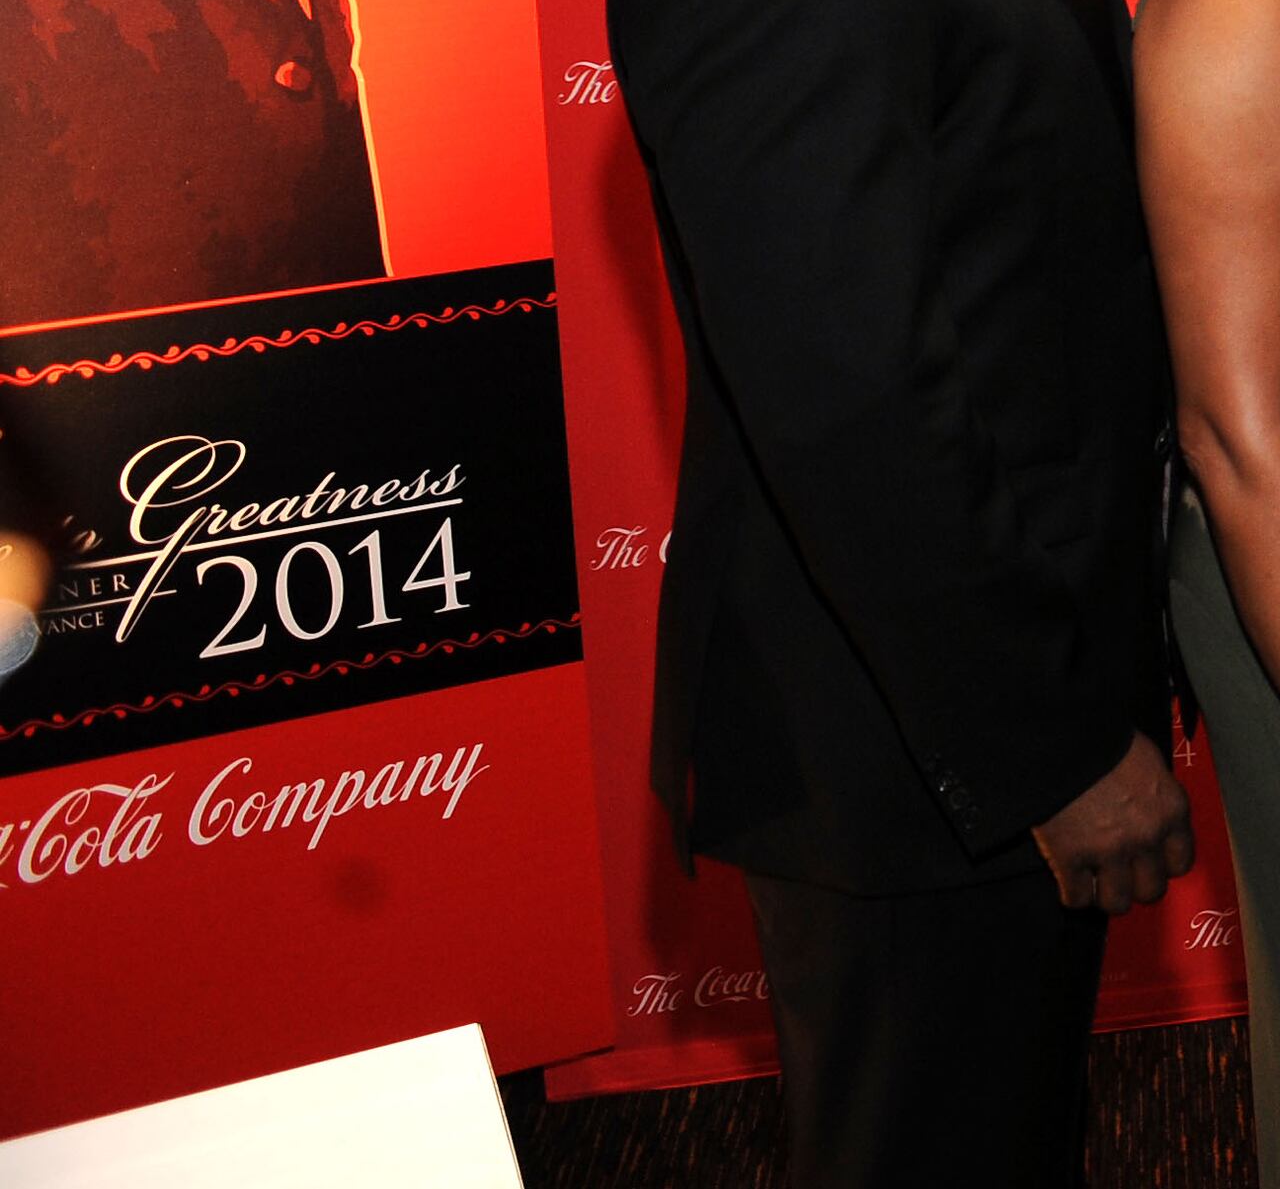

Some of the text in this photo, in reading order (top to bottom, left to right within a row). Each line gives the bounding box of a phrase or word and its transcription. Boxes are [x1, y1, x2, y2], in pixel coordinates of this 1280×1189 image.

[558, 60, 617, 105] The
[115, 434, 467, 644] Greatness
[591, 525, 649, 571] The
[58, 573, 132, 601] NER
[188, 510, 472, 659] 2014
[188, 743, 490, 851] Company
[1184, 908, 1239, 950] The
[625, 970, 686, 1018] The
